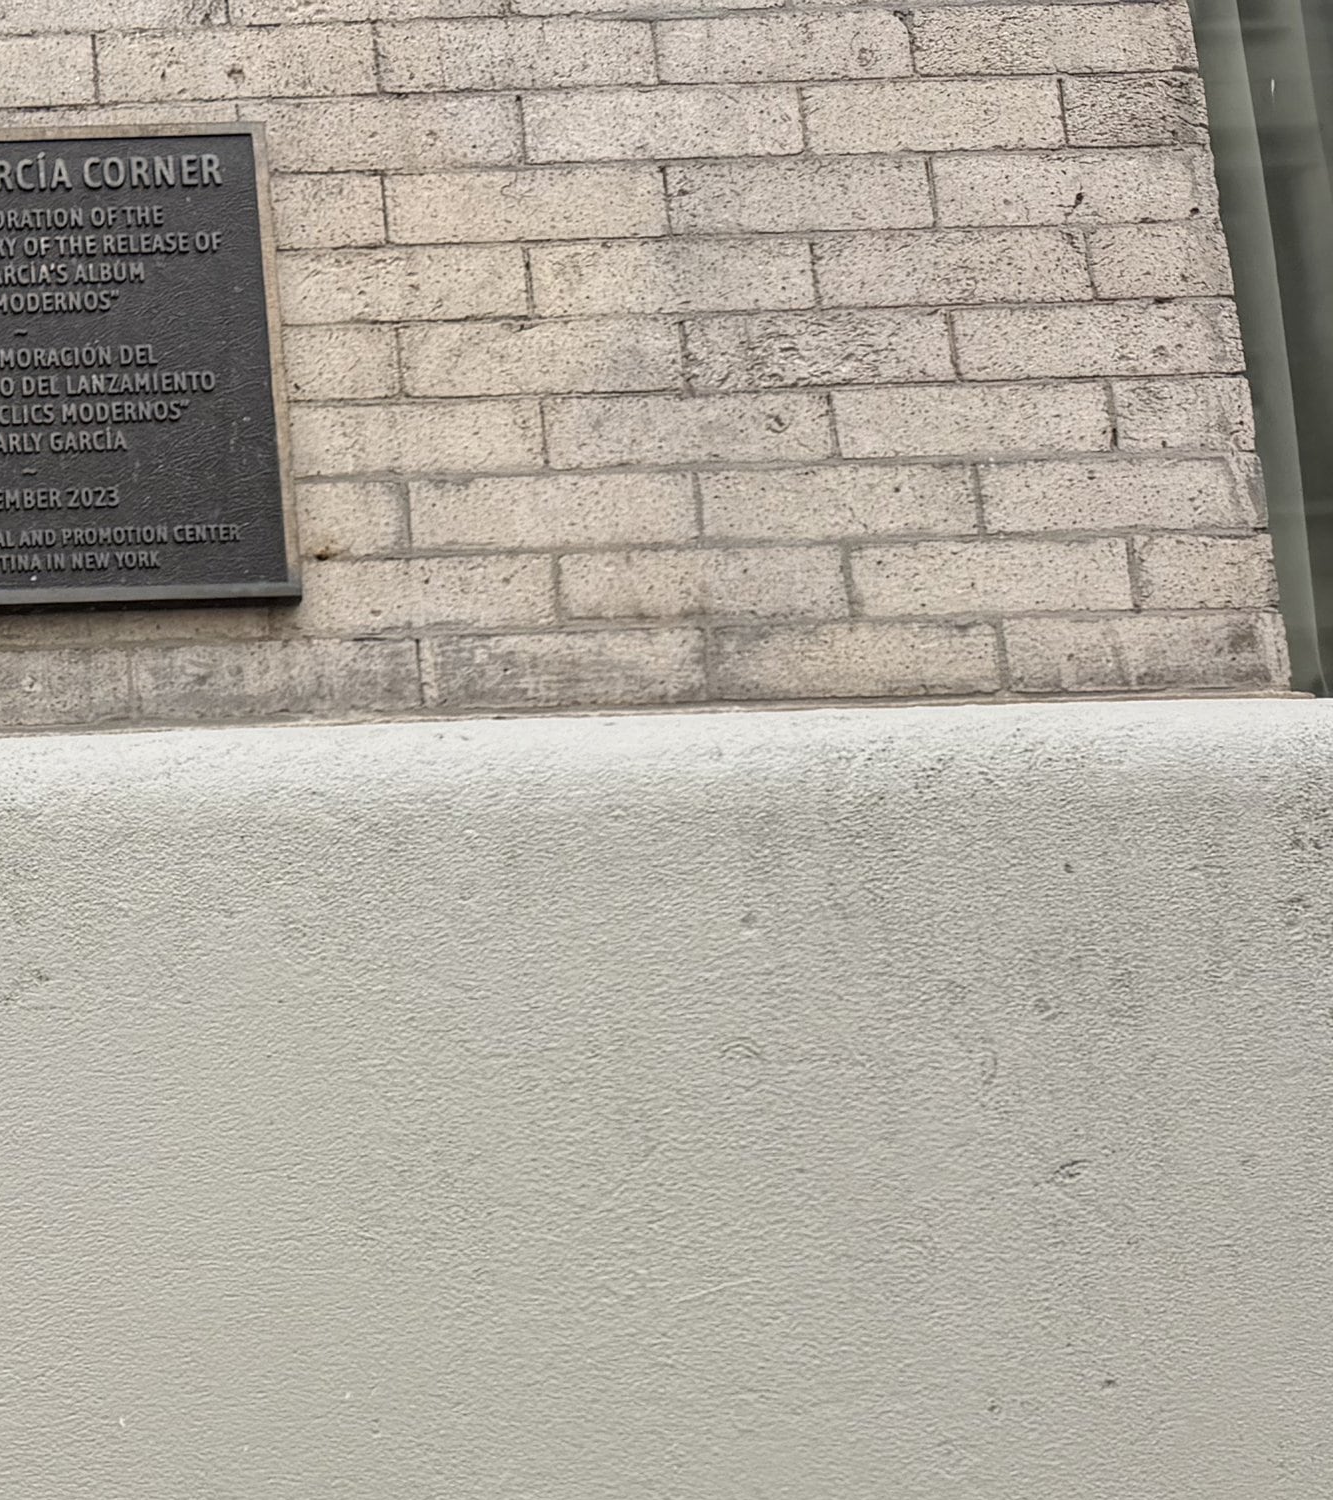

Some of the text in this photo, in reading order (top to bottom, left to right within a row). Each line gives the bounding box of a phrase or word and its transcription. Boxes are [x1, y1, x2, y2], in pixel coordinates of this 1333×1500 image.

[83, 154, 223, 190] CORNER
[90, 207, 118, 228] OF
[122, 205, 165, 227] THE
[23, 236, 51, 258] OF
[54, 235, 97, 256] THE
[102, 232, 191, 254] RELEASE
[195, 232, 223, 252] OF
[119, 344, 159, 367] DEL
[21, 375, 60, 398] DEL
[66, 370, 217, 396] LANZAMIENTO
[49, 426, 128, 453] GARCÍA
[66, 486, 121, 509] 2023
[18, 528, 57, 548] AND
[61, 525, 169, 547] PROMOTION
[173, 523, 241, 544] CENTER
[46, 552, 65, 571] IN
[71, 551, 110, 571] NEW
[113, 550, 161, 569] YORK
